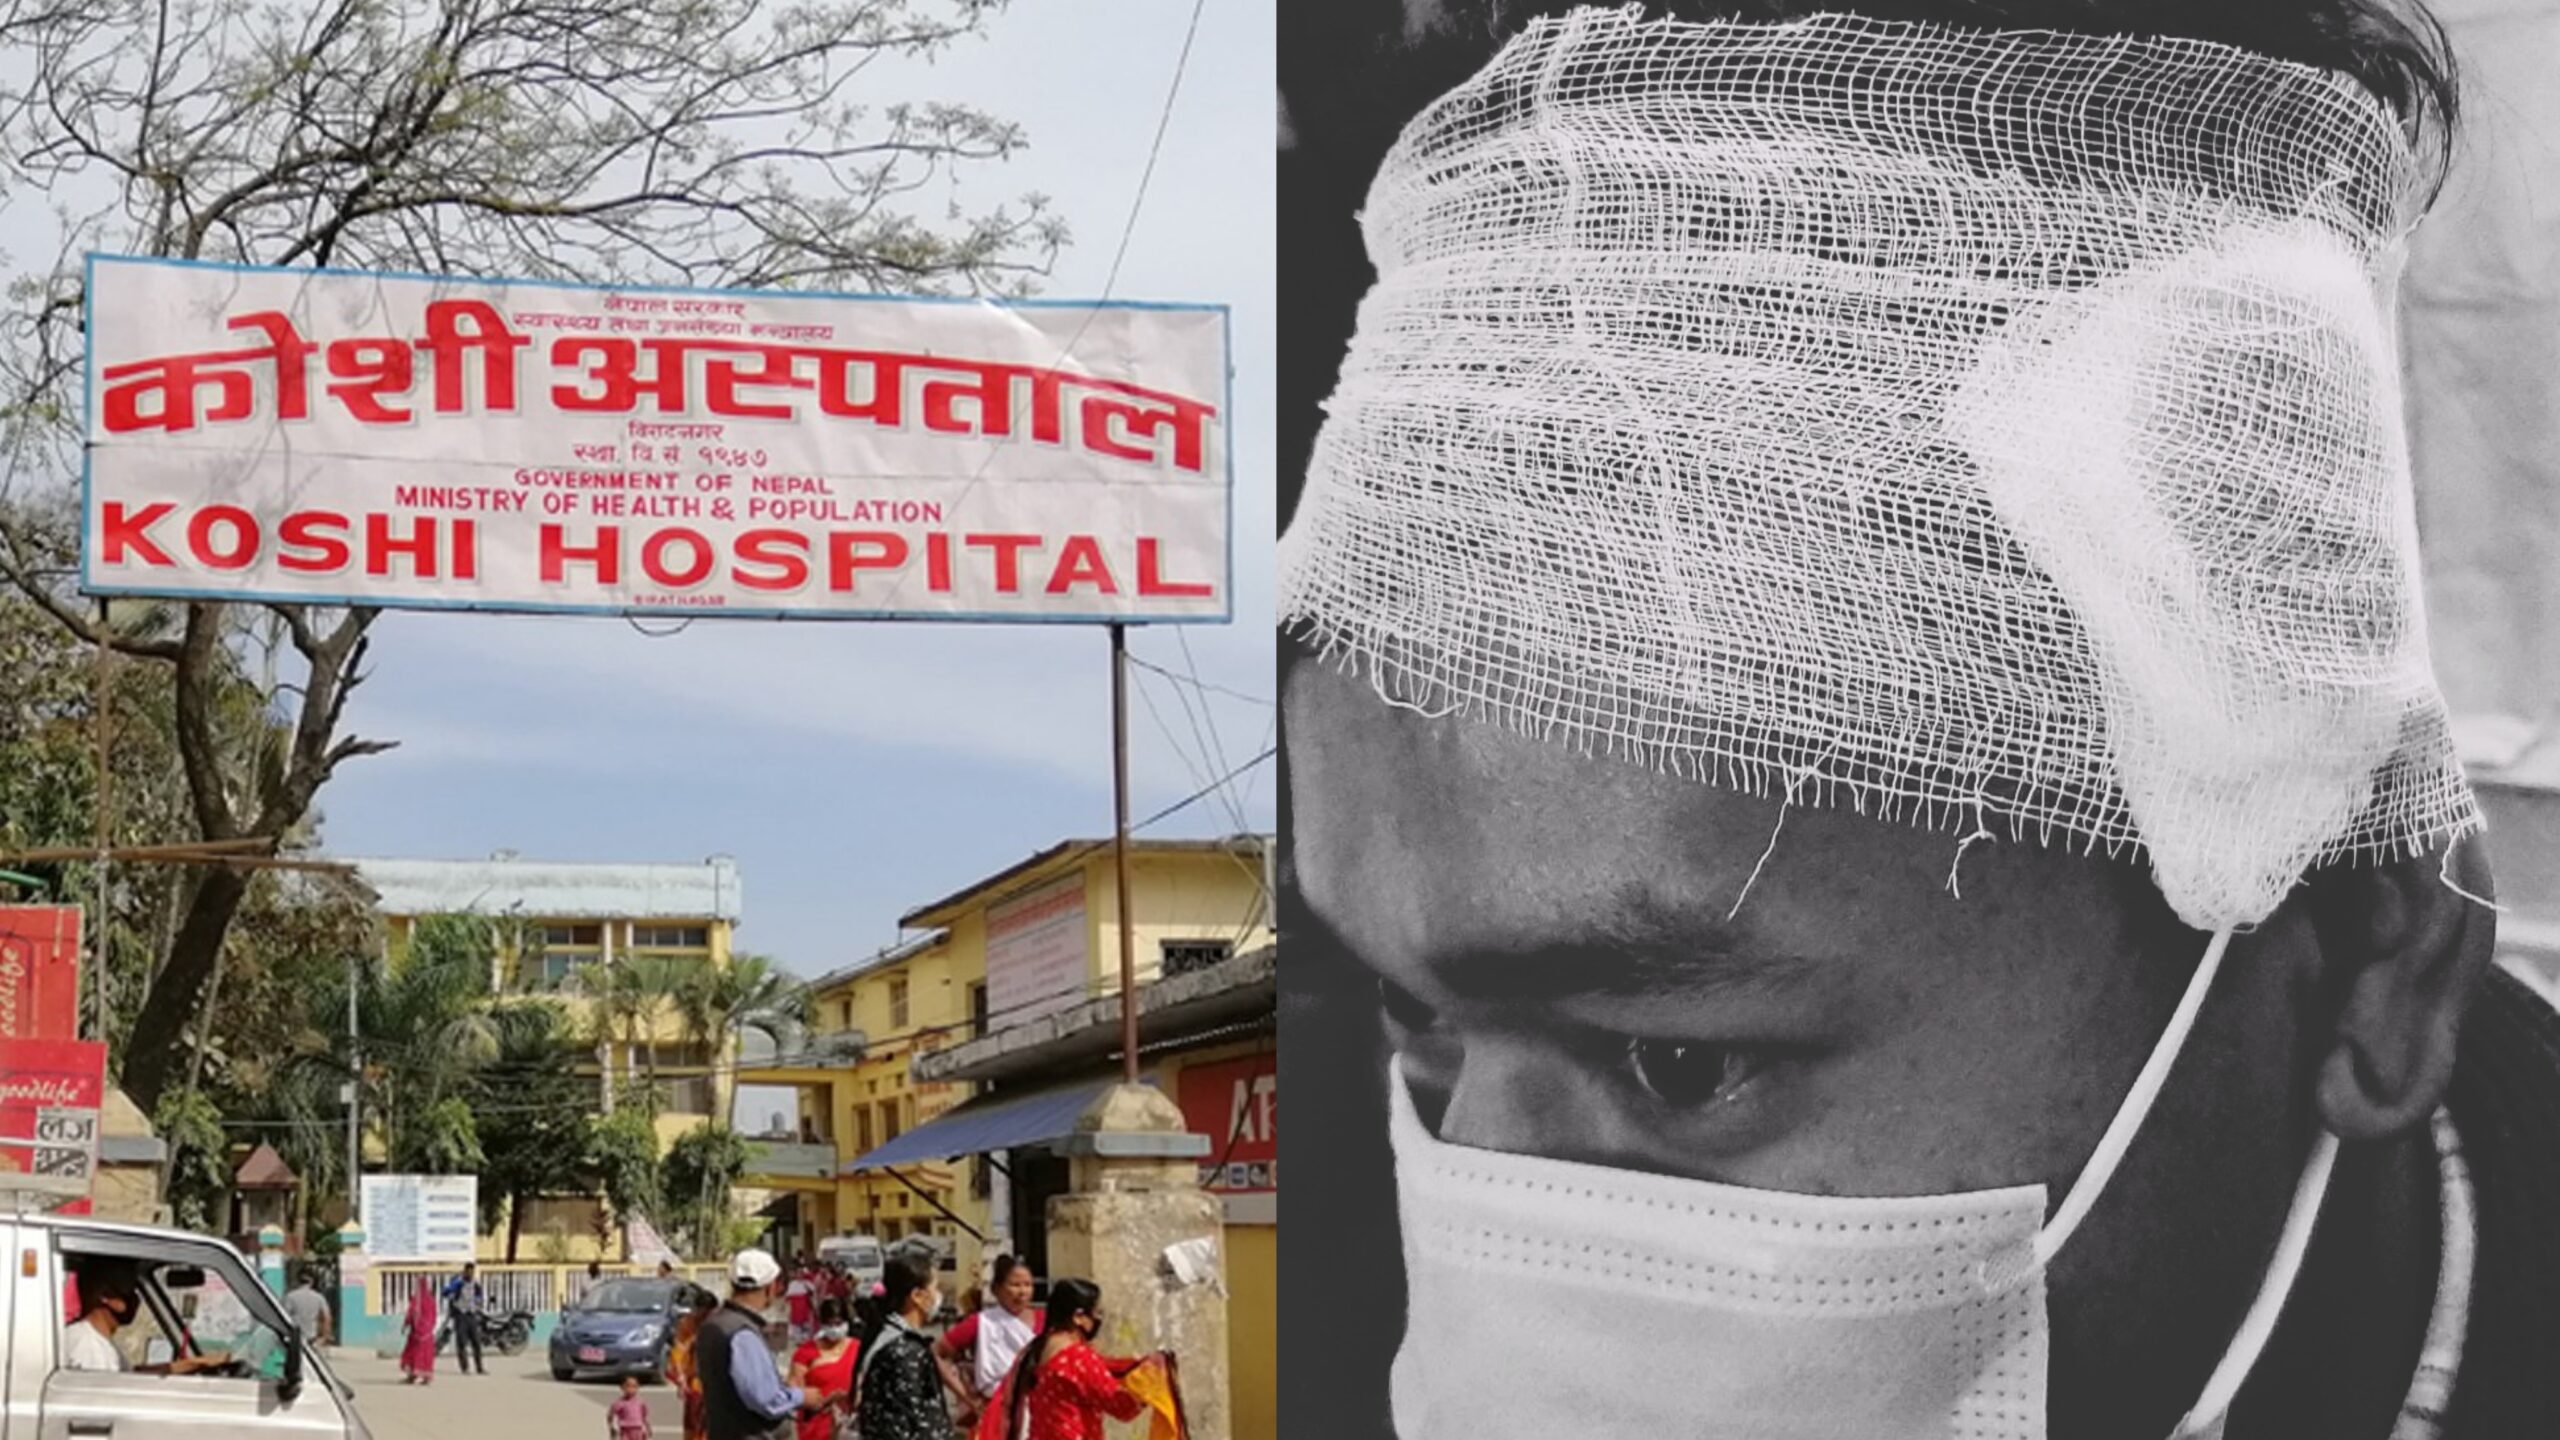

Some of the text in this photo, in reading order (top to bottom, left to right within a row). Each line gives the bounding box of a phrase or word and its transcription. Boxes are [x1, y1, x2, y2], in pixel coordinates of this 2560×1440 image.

[604, 295, 746, 320] नेपाल सरकार
[608, 316, 650, 335] तथा
[102, 299, 1217, 473] कोशी अस्पताल
[514, 468, 834, 495] GOVERNMENT OF NEPAL
[395, 484, 943, 523] MINISTRY OF HEALTH & POPULATION
[102, 502, 1213, 597] KOSHI HOSPITAL
